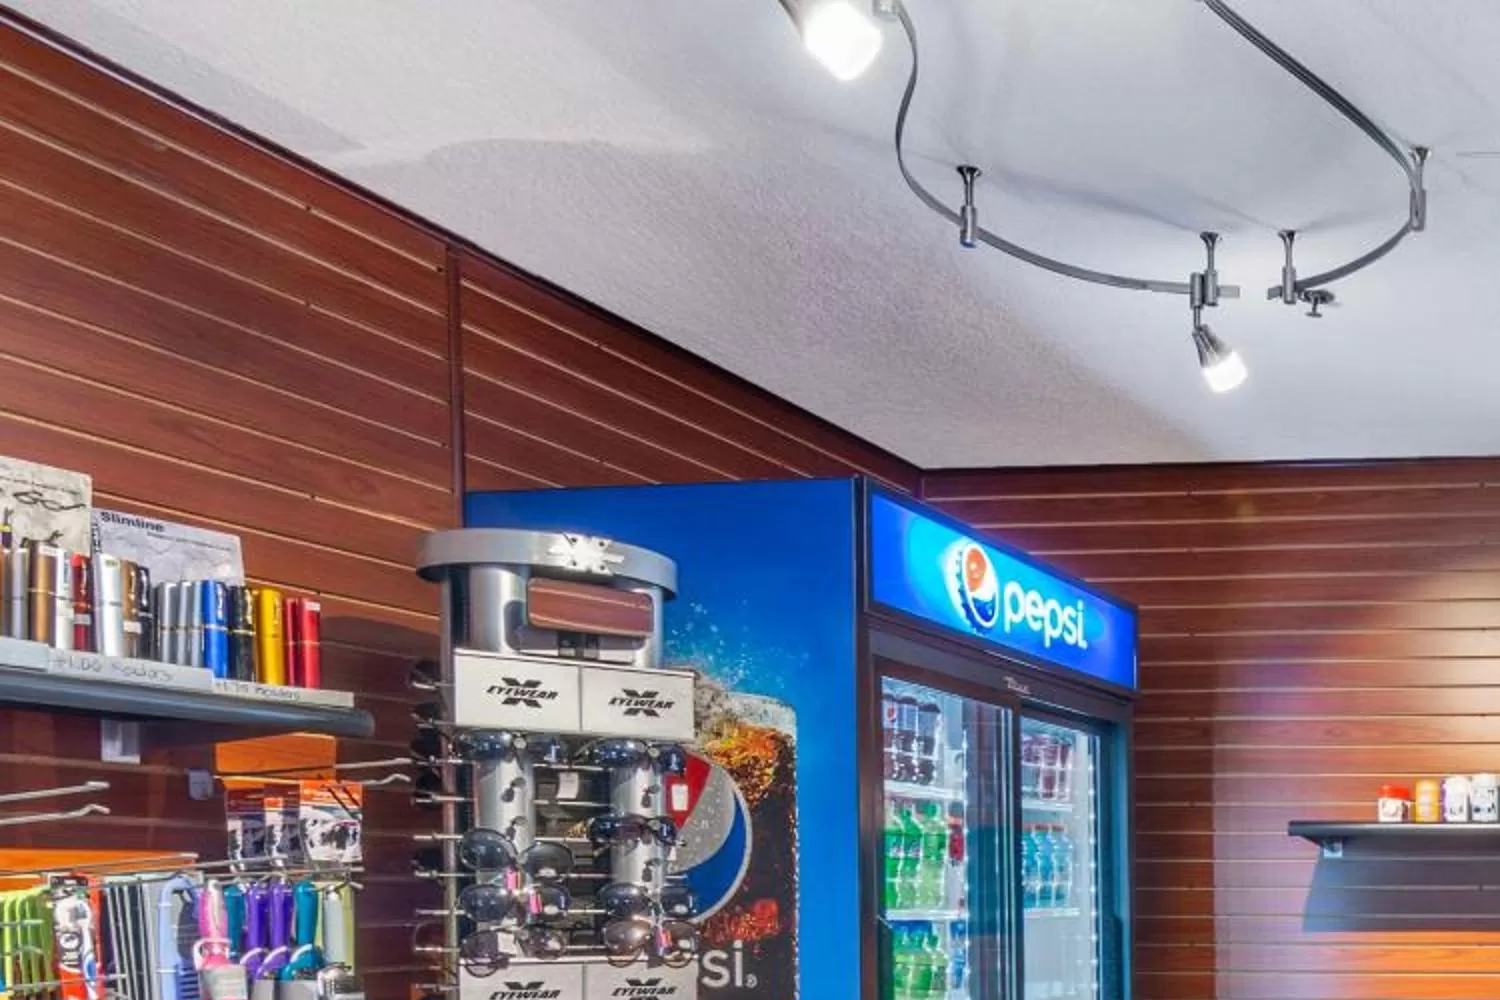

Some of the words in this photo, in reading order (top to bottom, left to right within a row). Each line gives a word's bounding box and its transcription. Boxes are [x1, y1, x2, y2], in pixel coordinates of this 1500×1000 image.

[100, 511, 165, 532] Slimline
[1003, 581, 1087, 649] pepsi
[486, 685, 559, 700] EYEWEAR
[608, 697, 675, 709] EYEWEAR
[490, 989, 561, 1000] EYEWEAR
[611, 986, 677, 997] EYEWEAR
